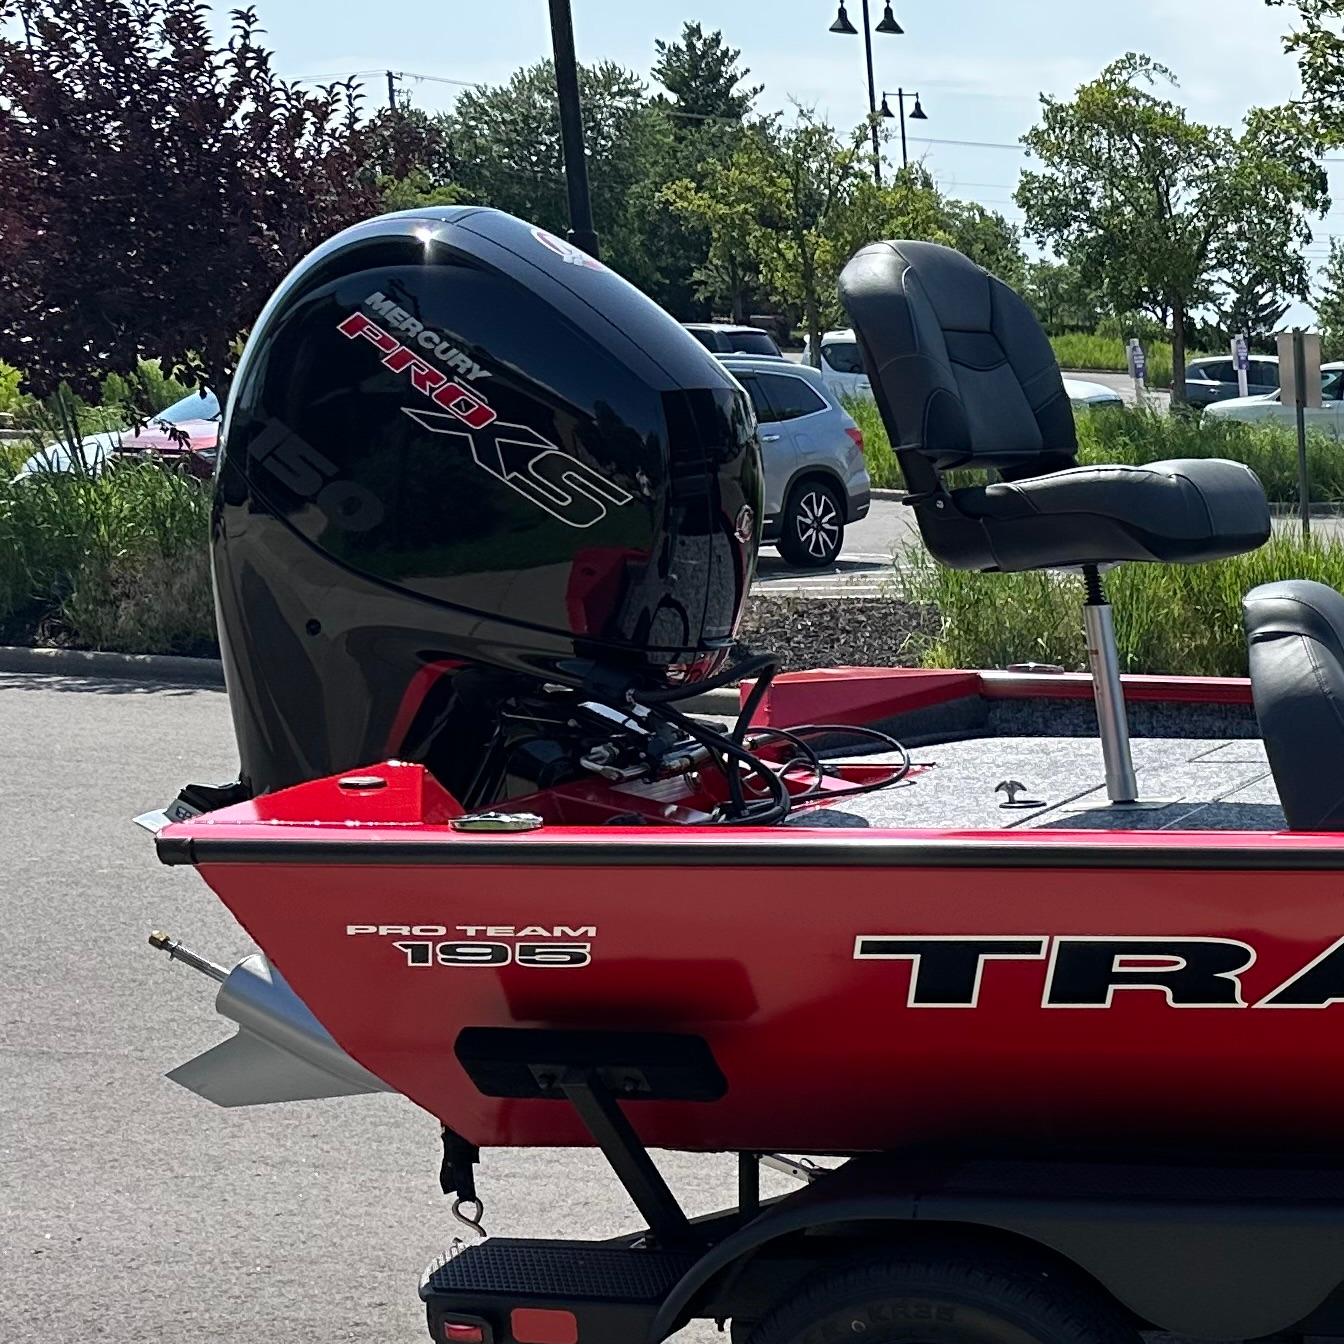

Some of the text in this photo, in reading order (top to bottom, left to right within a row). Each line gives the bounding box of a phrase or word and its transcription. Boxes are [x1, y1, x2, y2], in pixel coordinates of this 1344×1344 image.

[336, 312, 497, 429] PRO
[364, 291, 492, 381] MERCURY
[248, 417, 384, 531] 150
[401, 376, 633, 528] XS
[346, 924, 597, 937] PRO TEAM
[392, 940, 592, 968] 195
